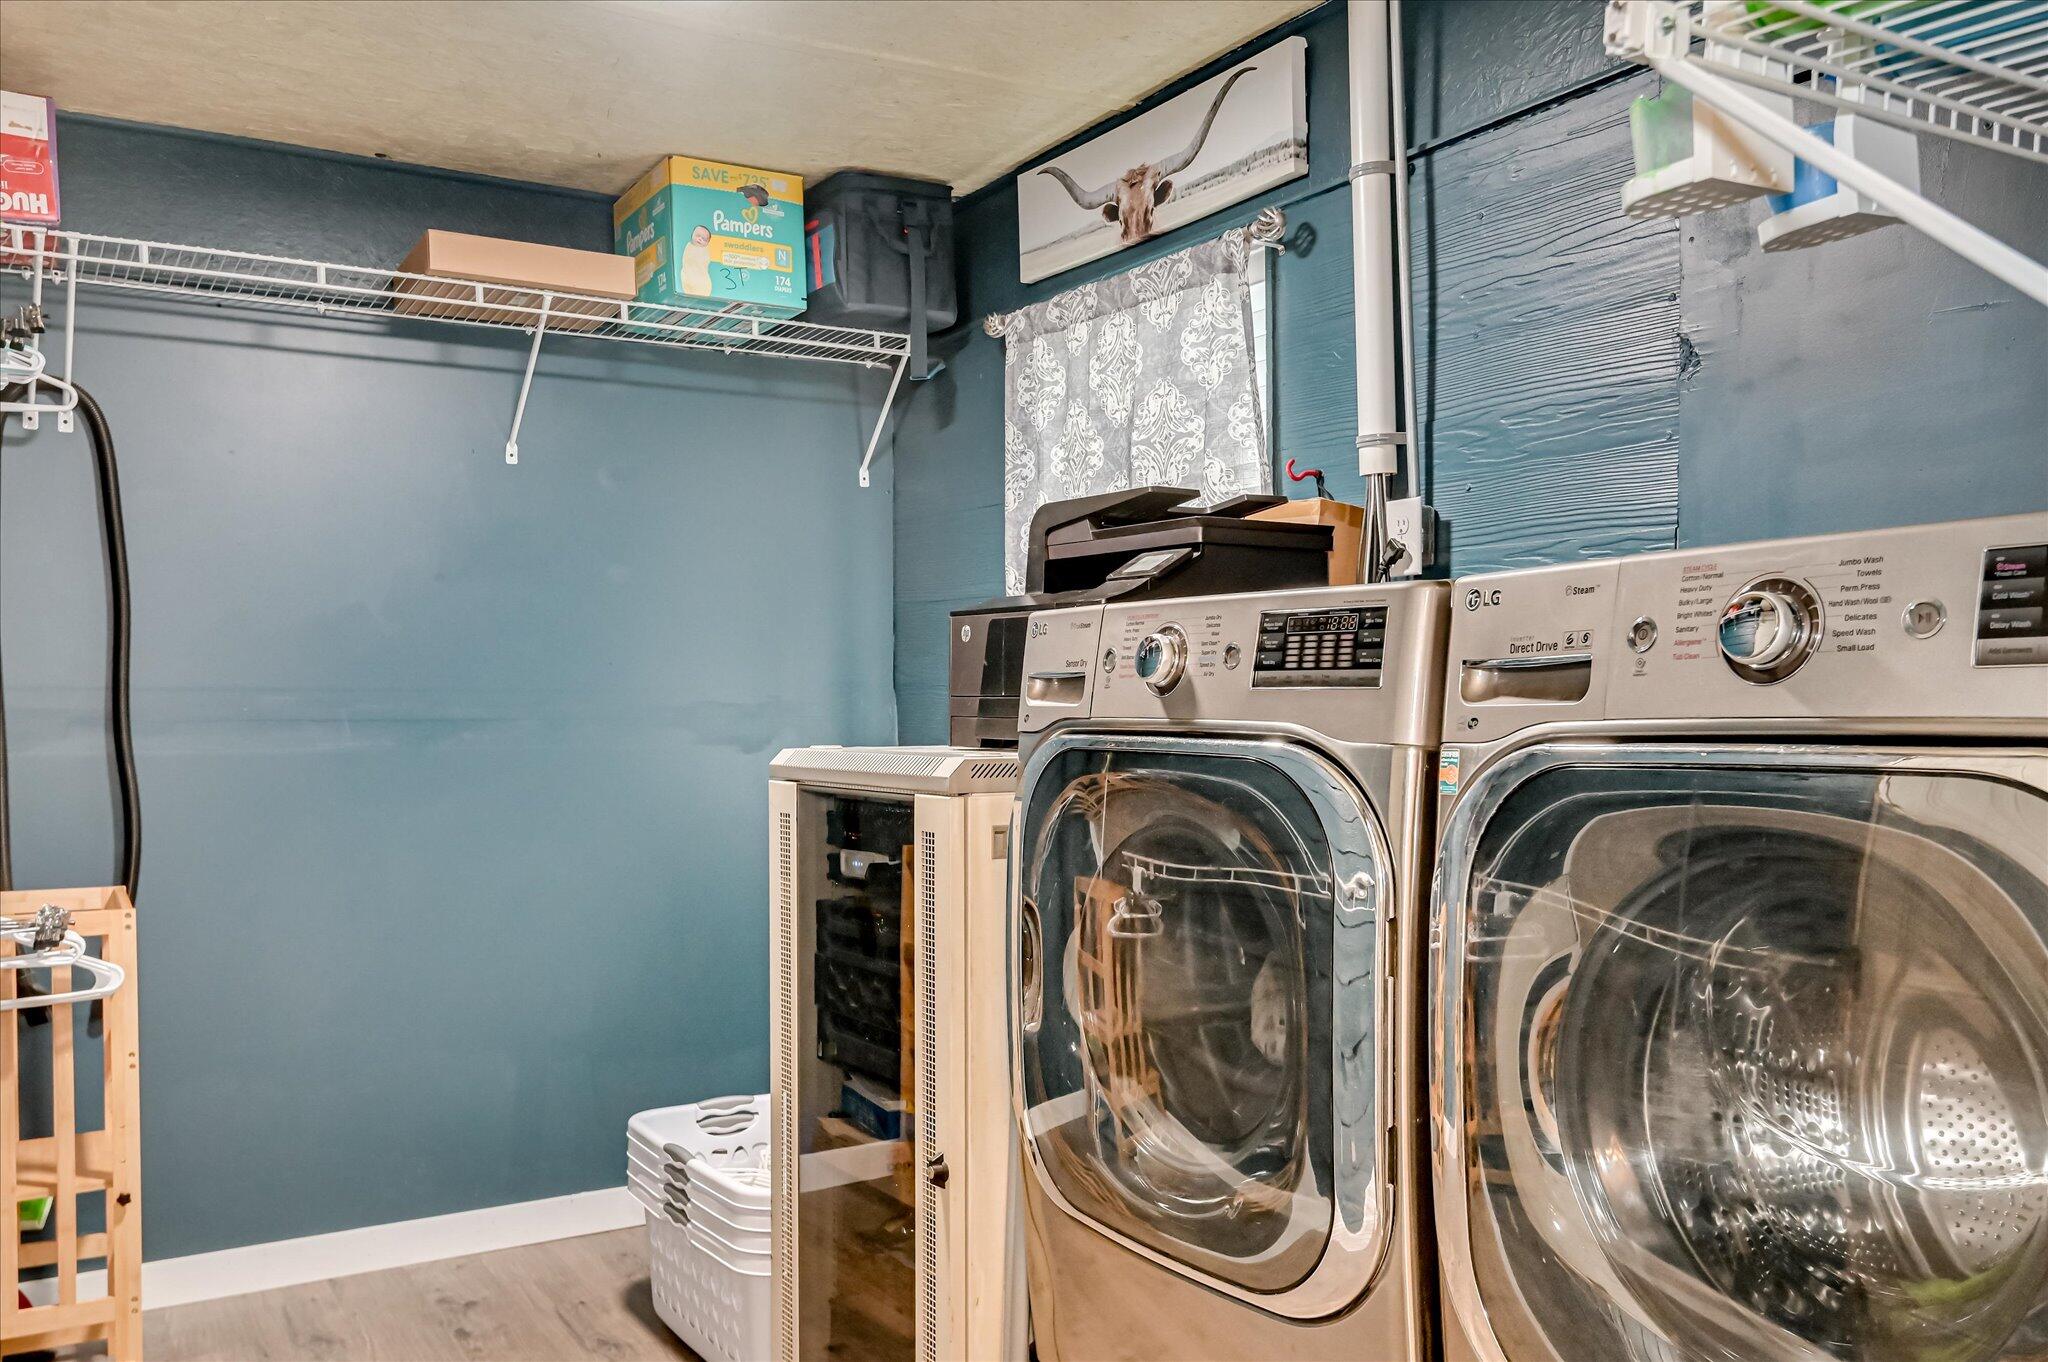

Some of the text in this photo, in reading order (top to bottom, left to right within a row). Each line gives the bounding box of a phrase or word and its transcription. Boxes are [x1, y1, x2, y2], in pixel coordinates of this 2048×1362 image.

[691, 165, 729, 184] SAVE
[713, 210, 774, 238] Pampers
[724, 242, 764, 253] swaddlers
[778, 248, 787, 261] N
[776, 275, 792, 287] 174
[1838, 556, 1884, 567] Jumbo Wash
[1856, 569, 1882, 577] Towels
[1680, 584, 1712, 594] Heavy Duty
[1992, 592, 2008, 600] Cold
[1676, 612, 1693, 620] Bright
[1844, 613, 1878, 622] Delicates
[2010, 620, 2032, 628] Wash
[1675, 626, 1700, 634] Sanitary
[1832, 628, 1876, 638] Speed Wash
[1509, 641, 1559, 654] Direct Drive
[1836, 643, 1875, 653] Small Load
[1065, 659, 1088, 668] Sensor Dry
